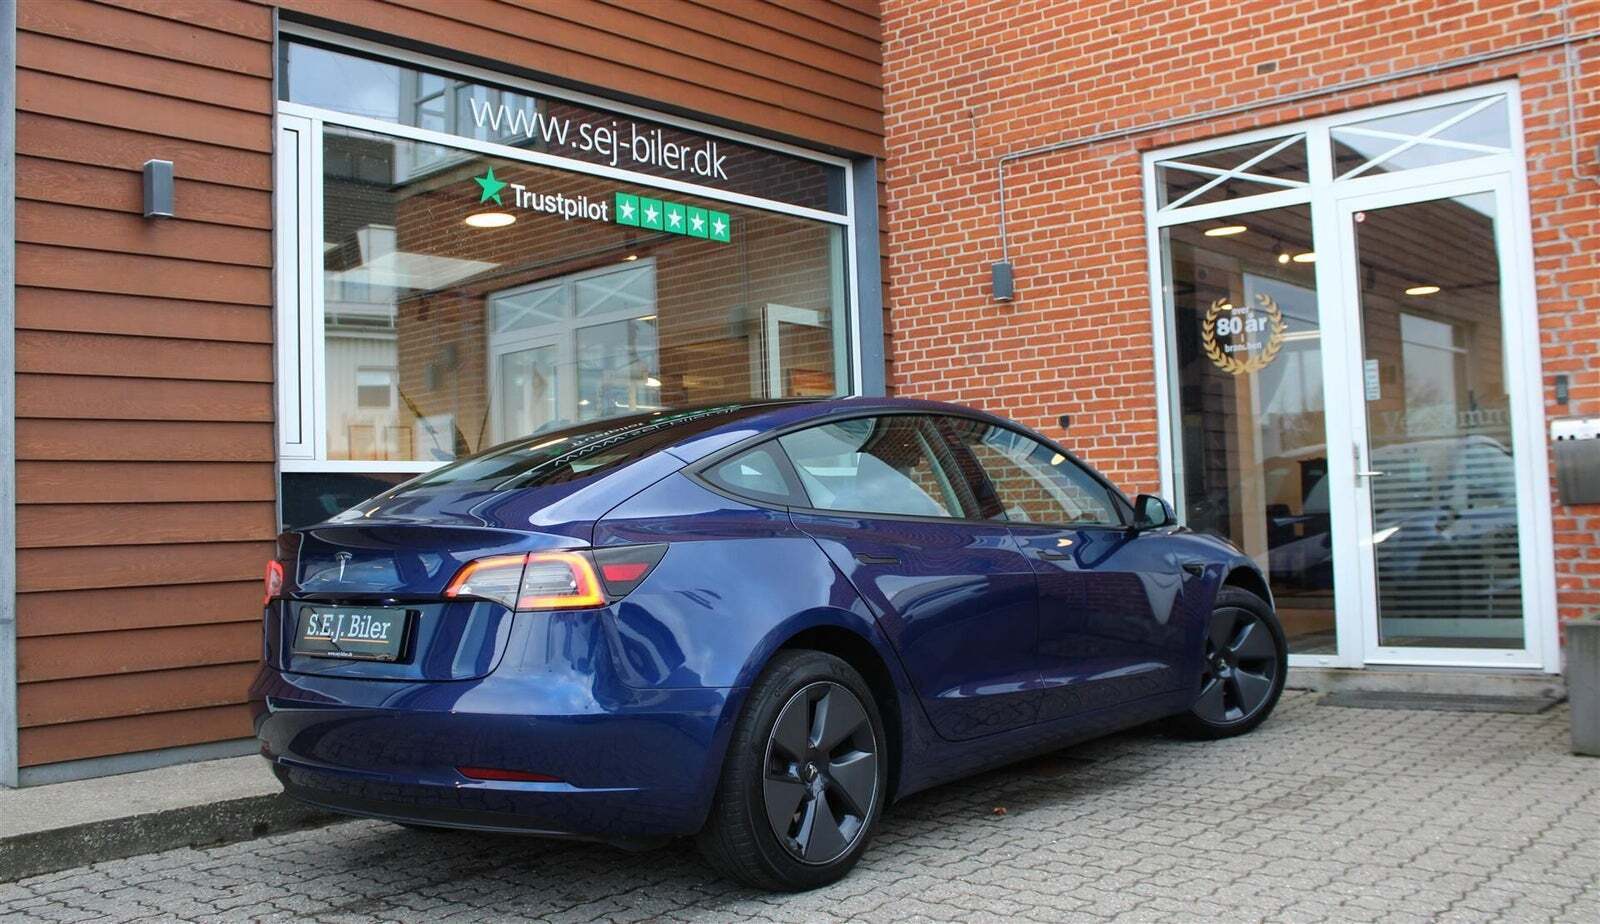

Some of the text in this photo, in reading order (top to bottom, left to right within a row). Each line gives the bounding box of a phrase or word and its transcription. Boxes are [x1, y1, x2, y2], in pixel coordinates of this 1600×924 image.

[470, 97, 728, 180] www.sej-biler.dk
[510, 183, 609, 222] Trustpilot
[1216, 313, 1268, 336] 80 år
[306, 613, 391, 643] S.E.J. Biler
